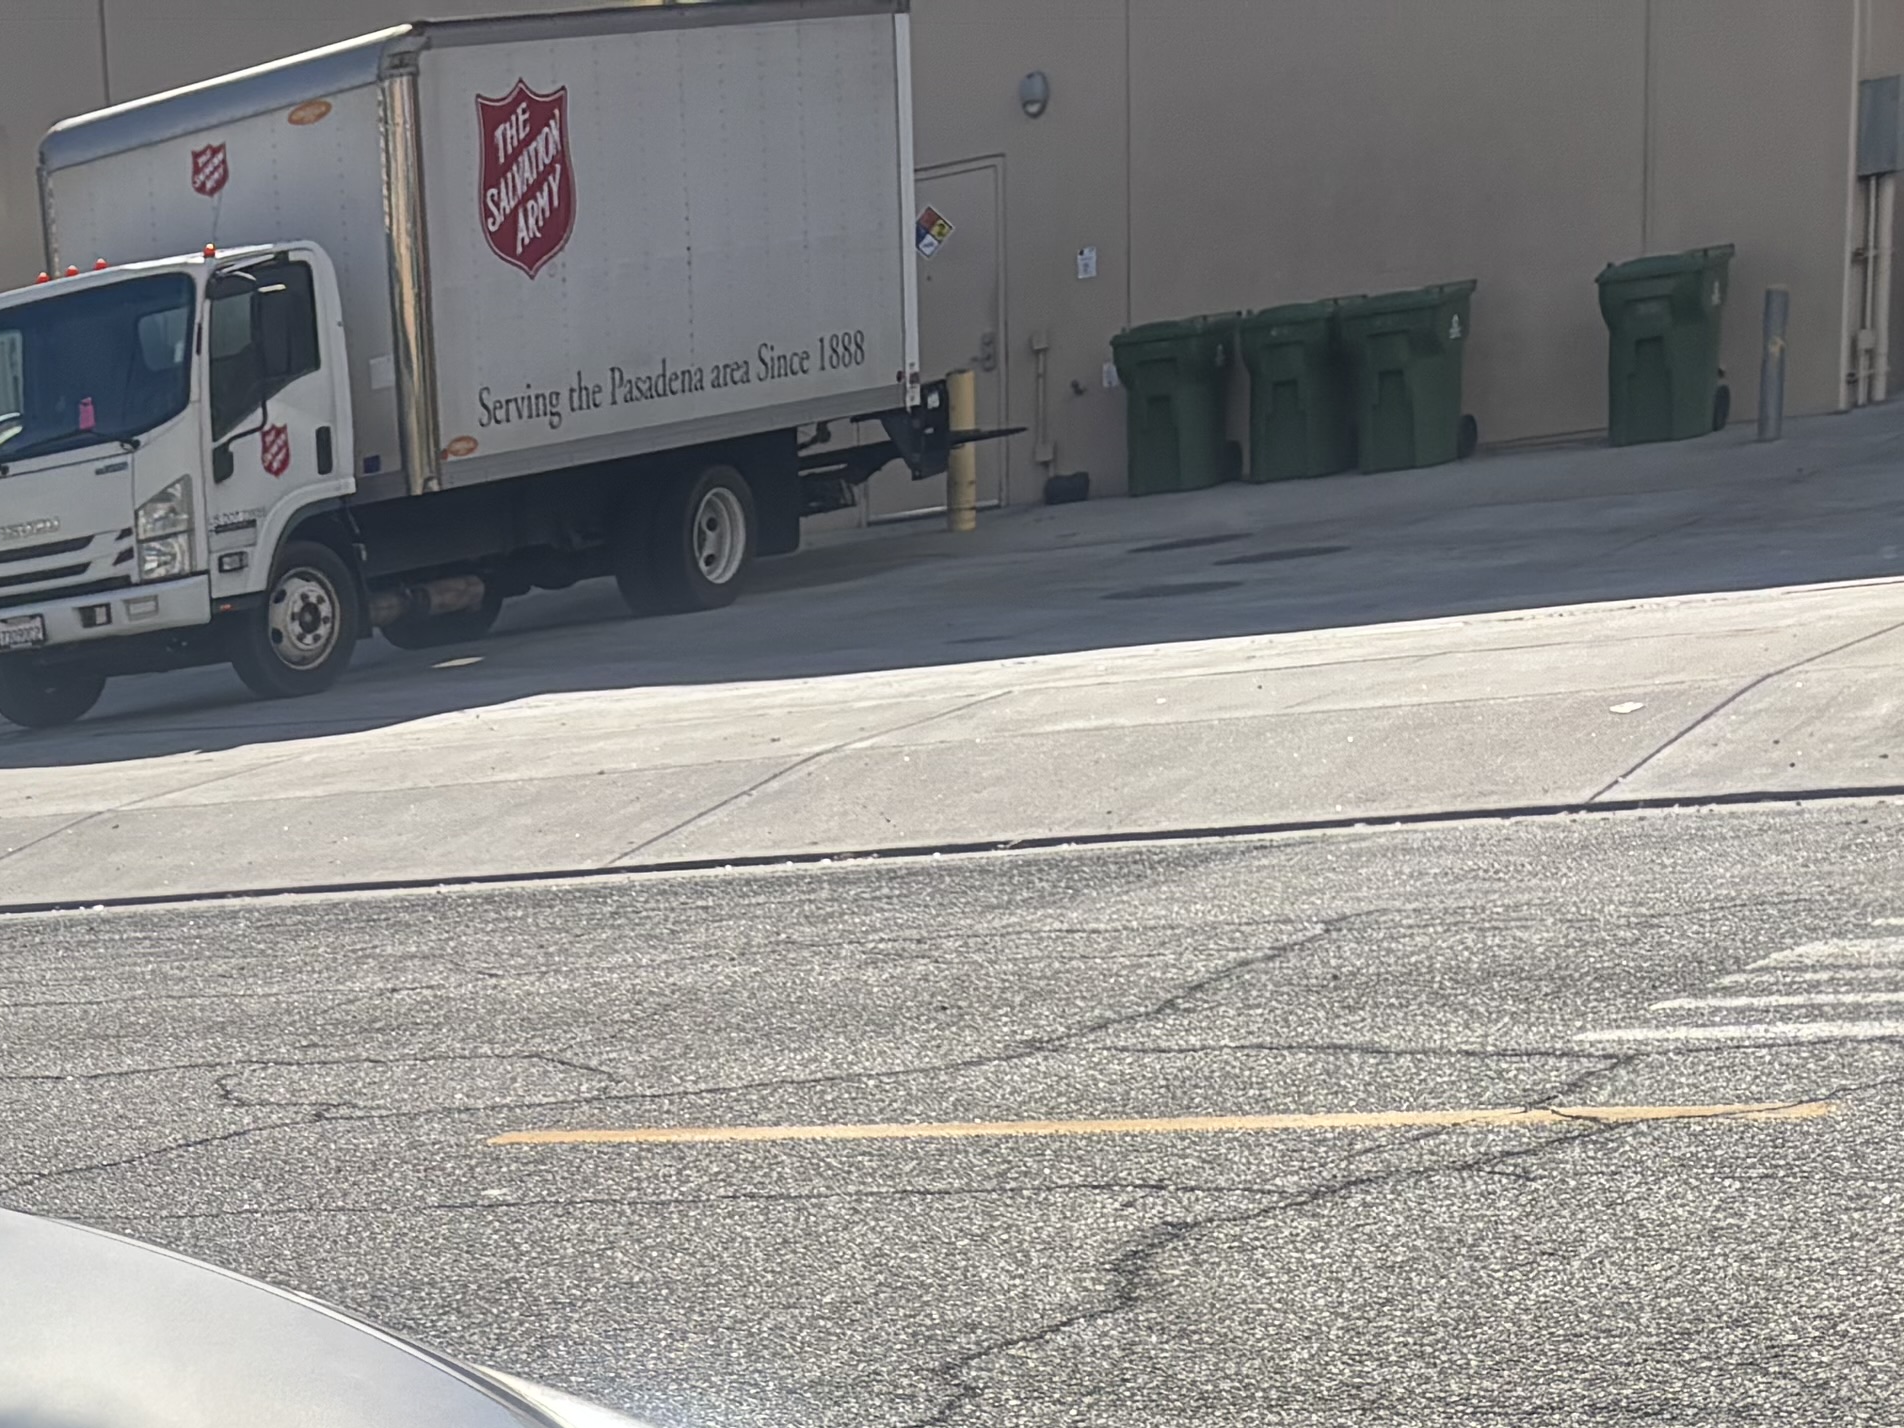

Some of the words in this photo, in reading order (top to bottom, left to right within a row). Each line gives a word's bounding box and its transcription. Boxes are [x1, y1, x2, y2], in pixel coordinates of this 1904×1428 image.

[487, 108, 561, 232] SALVATION
[495, 102, 530, 164] THE
[516, 163, 561, 255] ARMY
[478, 383, 562, 430] Serving
[568, 370, 603, 412] the
[609, 357, 705, 406] Pasadena
[710, 359, 751, 389] area
[756, 342, 811, 382] Since
[817, 330, 865, 371] 1888
